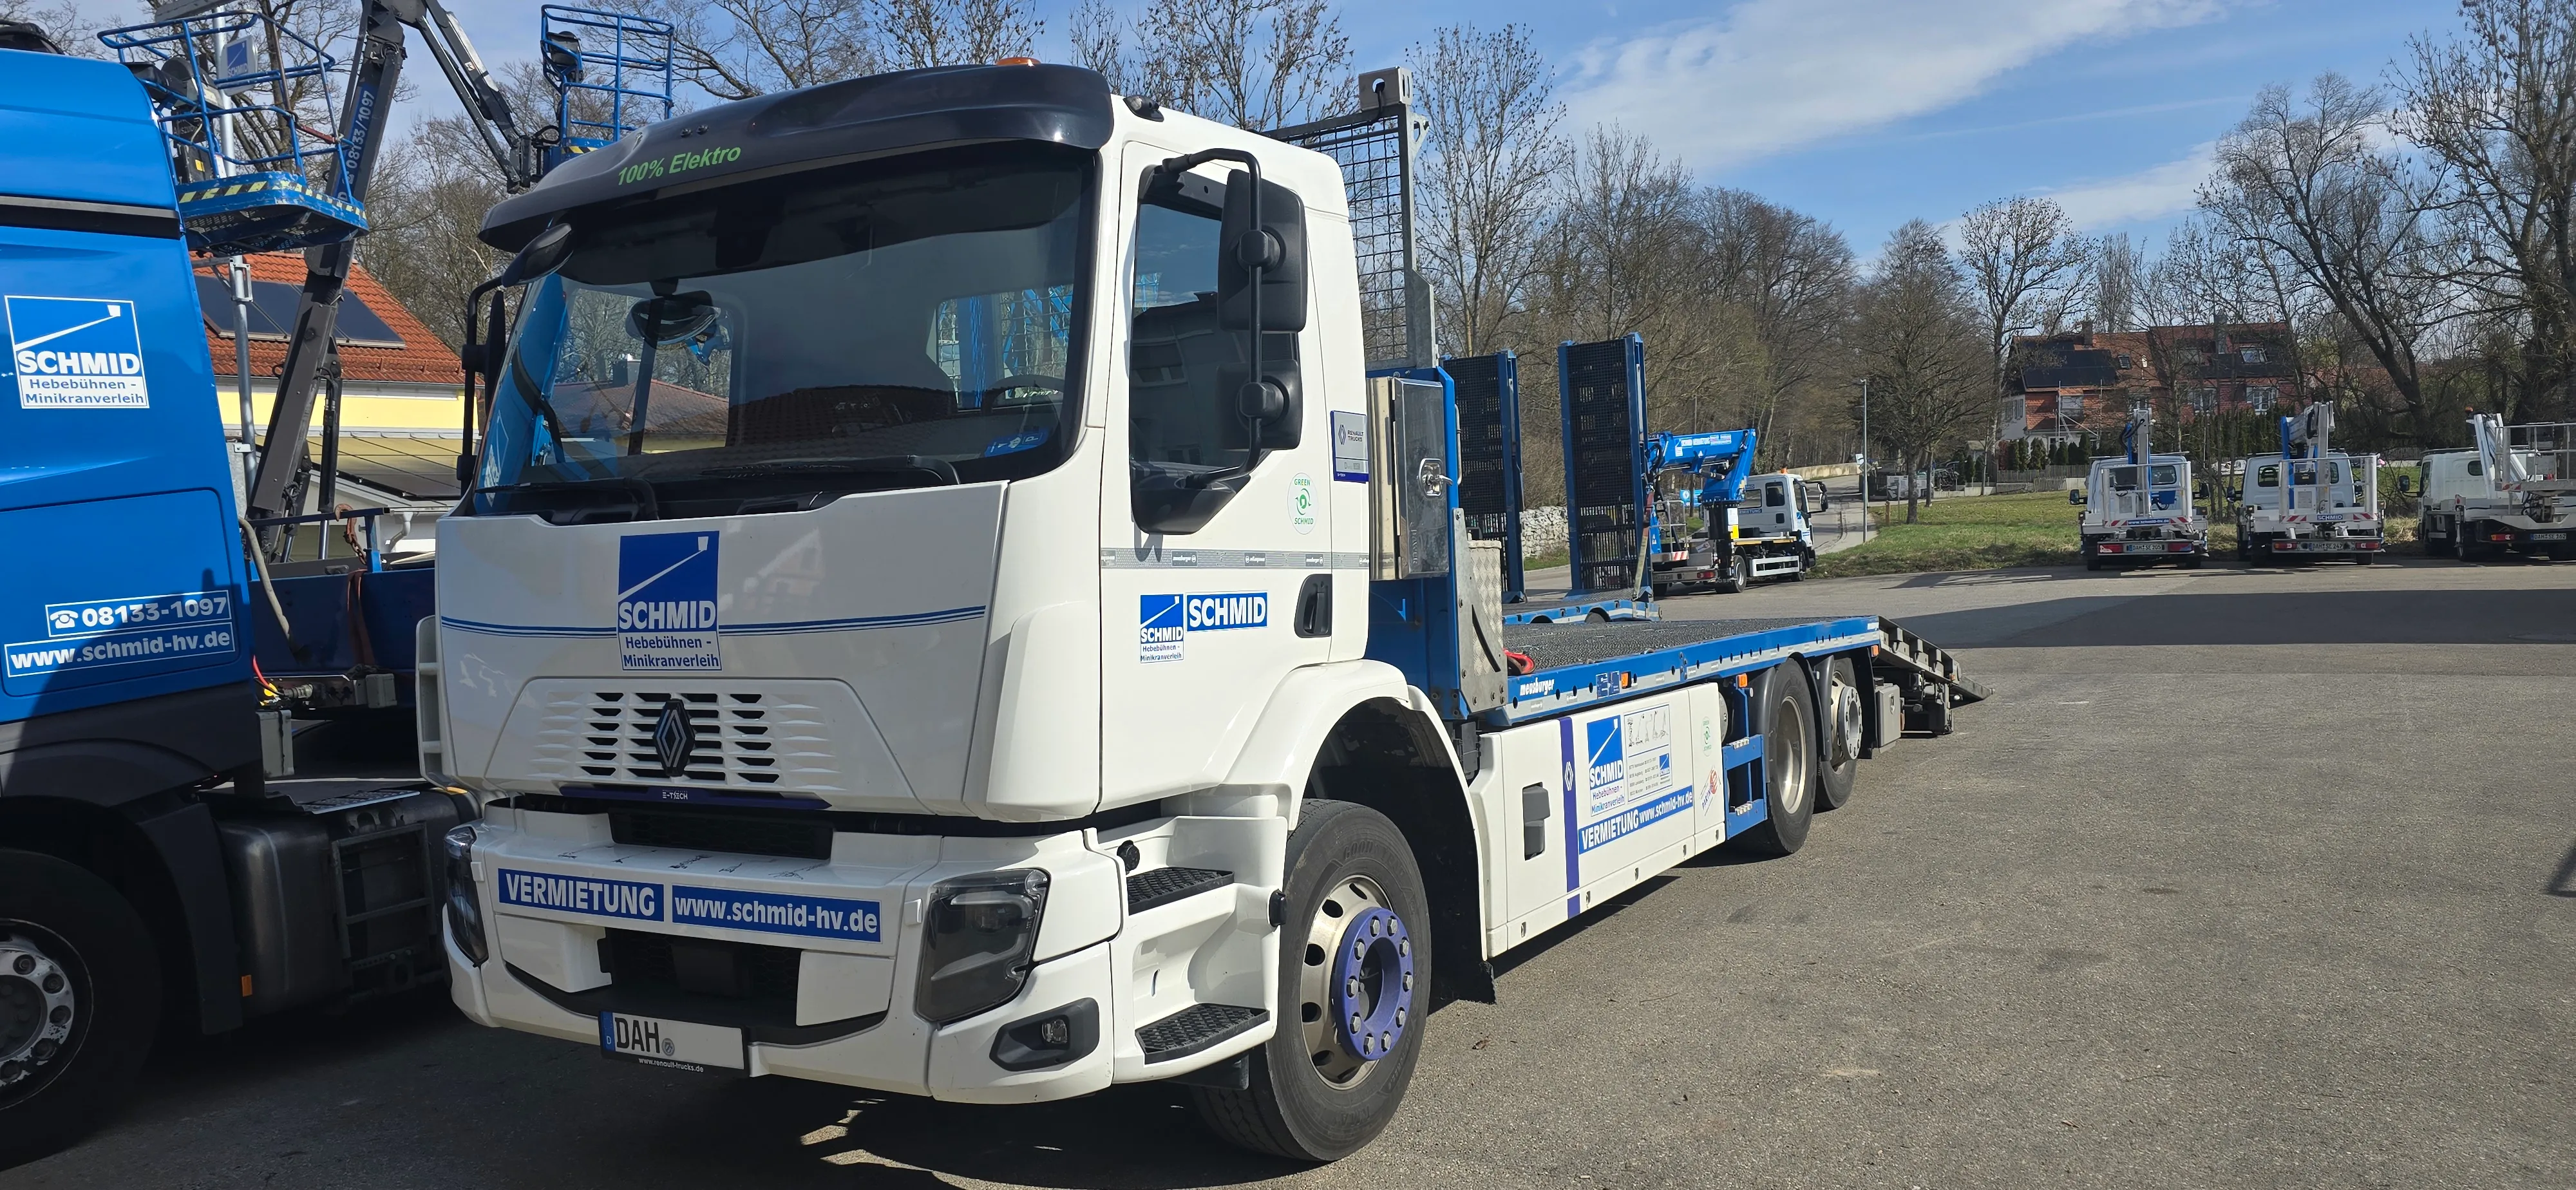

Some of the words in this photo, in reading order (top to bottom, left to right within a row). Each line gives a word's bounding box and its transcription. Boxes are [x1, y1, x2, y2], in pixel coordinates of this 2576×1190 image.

[228, 63, 248, 77] SCHMID
[346, 90, 375, 169] 08133/1097
[618, 158, 665, 185] 100%
[669, 147, 741, 174] Elektro
[17, 350, 140, 375] SCHMID
[30, 379, 126, 389] Hebebühnen
[26, 393, 144, 403] Minikranverleih
[82, 597, 227, 627] 08133-1097
[619, 600, 716, 630] SCHMID
[1189, 596, 1266, 627] SCHMID
[625, 636, 702, 648] Hebebühnen
[1141, 627, 1183, 643] SCHMID
[10, 631, 230, 669] www.schmid-hv.de
[623, 654, 719, 667] Minikranverleih
[1141, 653, 1182, 662] Minikranverleih
[1142, 644, 1176, 652] Hebebühnen
[1520, 677, 1555, 696] meusburger
[1589, 760, 1624, 788] SCHMID
[663, 791, 688, 800] E-TECH
[1591, 795, 1624, 814] Minikranverleih
[1639, 790, 1692, 824] www.schmid-hv.de
[1582, 809, 1639, 850] VERMIETUNG
[506, 873, 655, 916] VERMIETUNG
[675, 896, 878, 933] www.schmid-hv.de
[606, 1035, 612, 1044] D
[614, 1017, 661, 1053] DAH
[638, 1057, 704, 1073] www.renault-trucks.de
